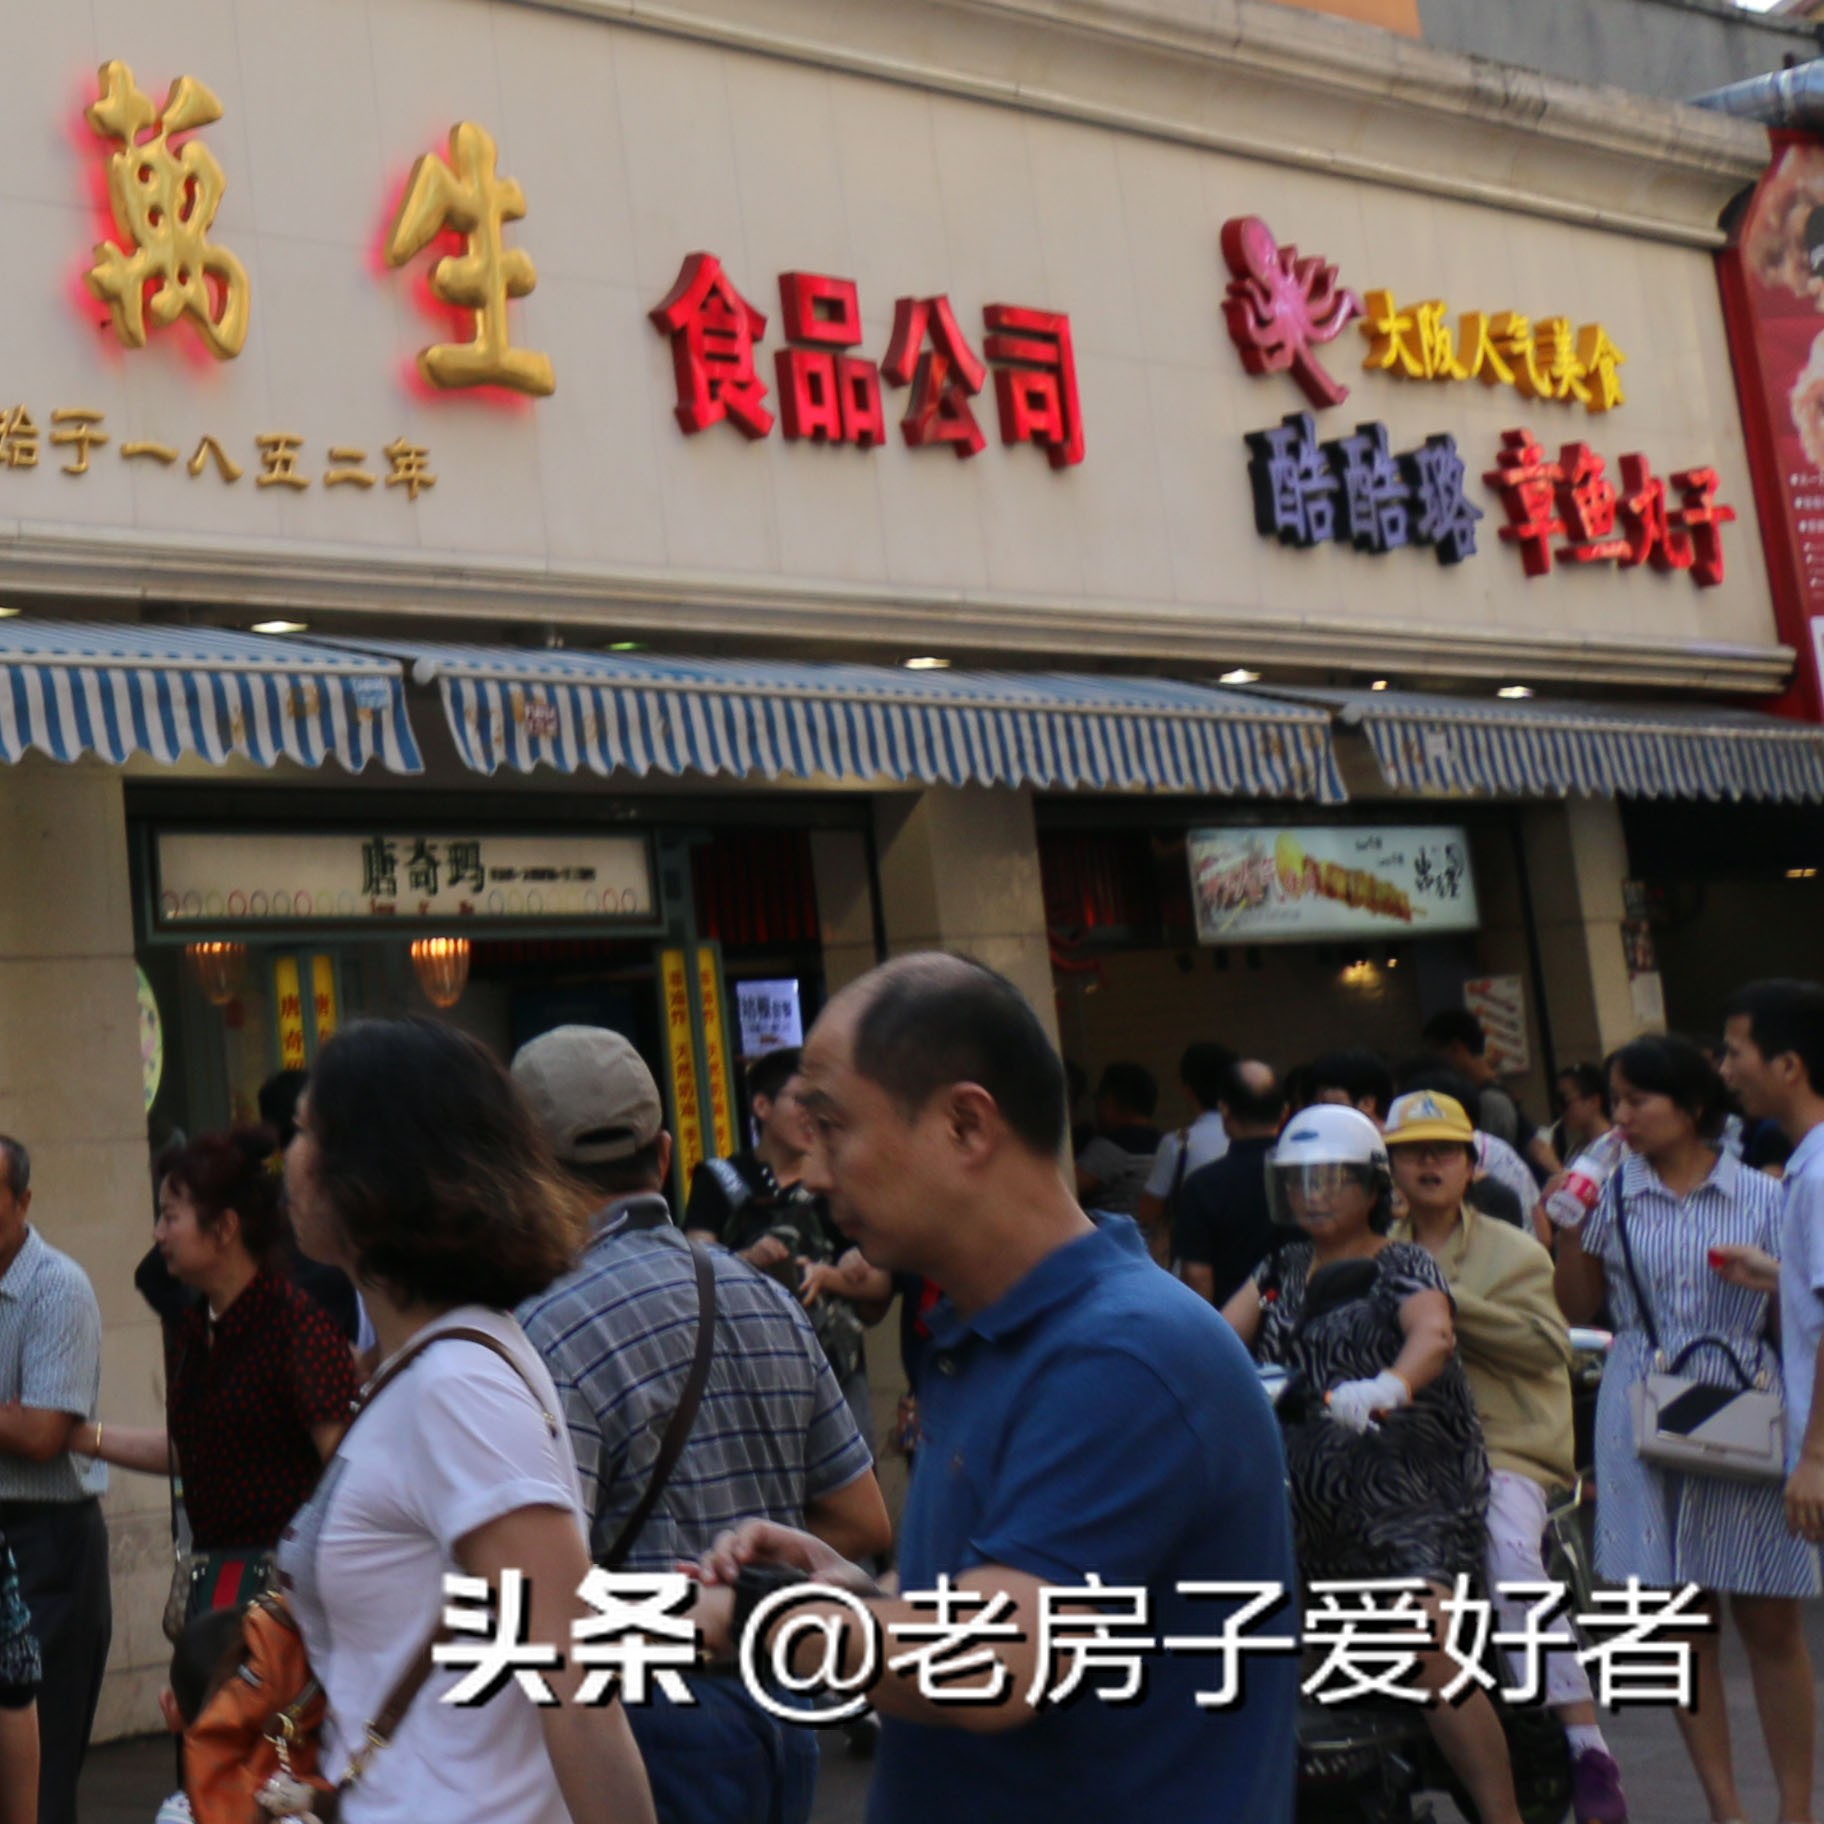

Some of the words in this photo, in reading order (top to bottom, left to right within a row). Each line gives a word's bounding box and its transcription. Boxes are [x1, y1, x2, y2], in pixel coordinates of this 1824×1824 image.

[649, 250, 1086, 469] 食品公司
[1360, 288, 1627, 413] 大阪人气美食
[1483, 428, 1737, 587] 章鱼丸子
